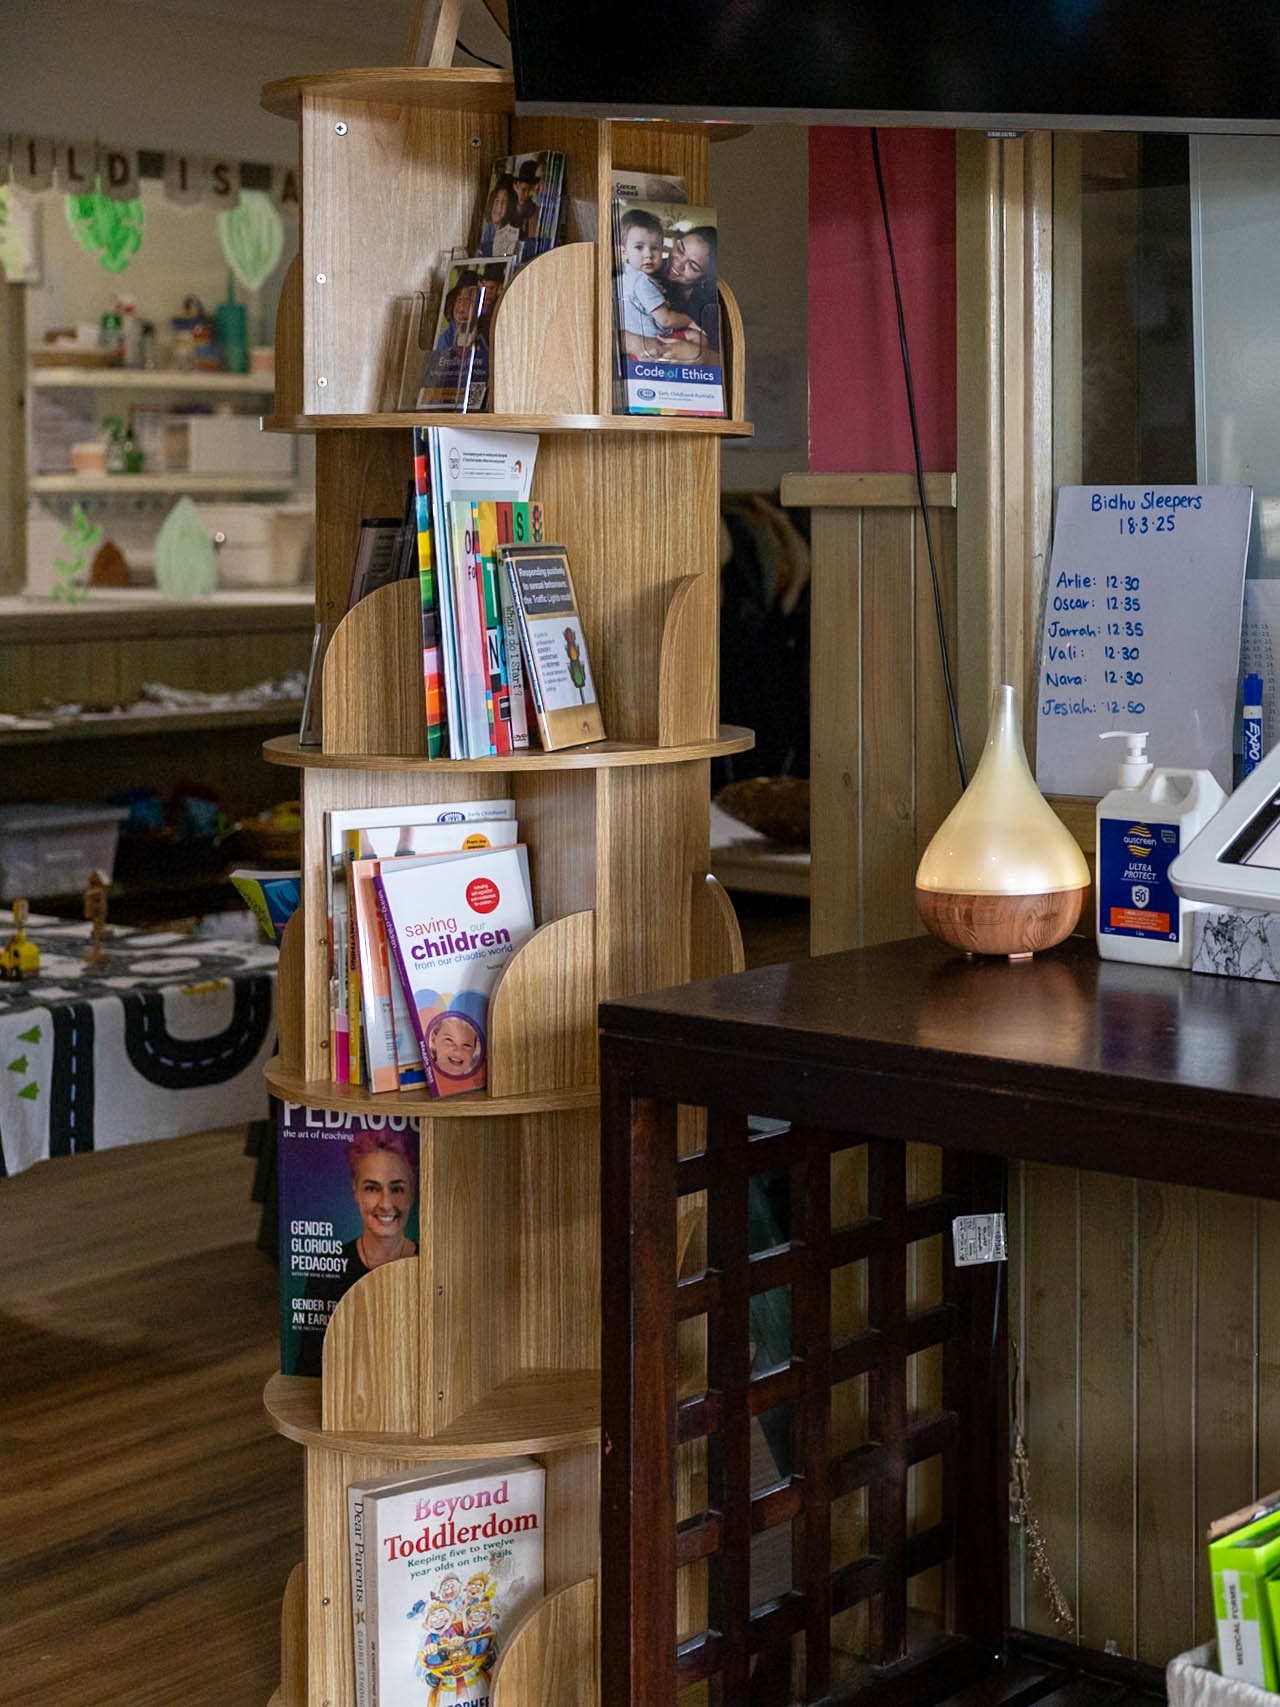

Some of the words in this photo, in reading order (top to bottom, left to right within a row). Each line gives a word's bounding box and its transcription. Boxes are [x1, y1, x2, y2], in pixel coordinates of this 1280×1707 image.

[178, 157, 231, 196] IS
[635, 364, 664, 377] Code
[667, 367, 679, 378] of
[682, 368, 714, 381] Ethics
[1091, 494, 1135, 512] Bidhu
[1140, 491, 1203, 514] Sleepers
[518, 566, 547, 577] Responding
[1056, 571, 1097, 588] Arlie:
[1053, 596, 1096, 611] Oscar:
[1048, 621, 1101, 638] Jarrah:
[1048, 645, 1085, 661] Vali:
[1046, 672, 1087, 687] Nara:
[1042, 699, 1097, 716] Jesiah:
[1123, 837, 1157, 846] auscreen
[1124, 870, 1157, 881] PROTECT
[1128, 863, 1152, 872] ULTRA
[405, 916, 457, 938] saving
[470, 922, 486, 932] our
[411, 928, 511, 961] children
[414, 960, 435, 971] from
[437, 958, 452, 967] our
[454, 951, 486, 963] chaotic
[487, 943, 513, 956] world
[283, 1130, 296, 1138] the
[298, 1131, 309, 1139] art
[310, 1131, 320, 1139] of
[321, 1131, 354, 1143] teaching
[291, 1220, 333, 1237] GENDER
[291, 1237, 343, 1255] GLORIOUS
[291, 1255, 348, 1273] PEDAGOGY
[291, 1297, 324, 1311] GENDER
[292, 1312, 305, 1324] AN
[413, 1480, 510, 1522] Beyond
[354, 1502, 364, 1539] Dear
[384, 1512, 539, 1562] Toddlerdom
[407, 1553, 447, 1568] Keeping
[449, 1548, 467, 1557] five
[470, 1545, 480, 1553] to
[483, 1538, 515, 1550] twelve
[354, 1543, 366, 1603] Parents
[410, 1568, 431, 1581] year
[434, 1561, 455, 1572] olds
[457, 1559, 470, 1567] on
[473, 1554, 489, 1563] the
[1229, 1584, 1239, 1620] FORMS
[1233, 1623, 1243, 1665] MEDICAL
